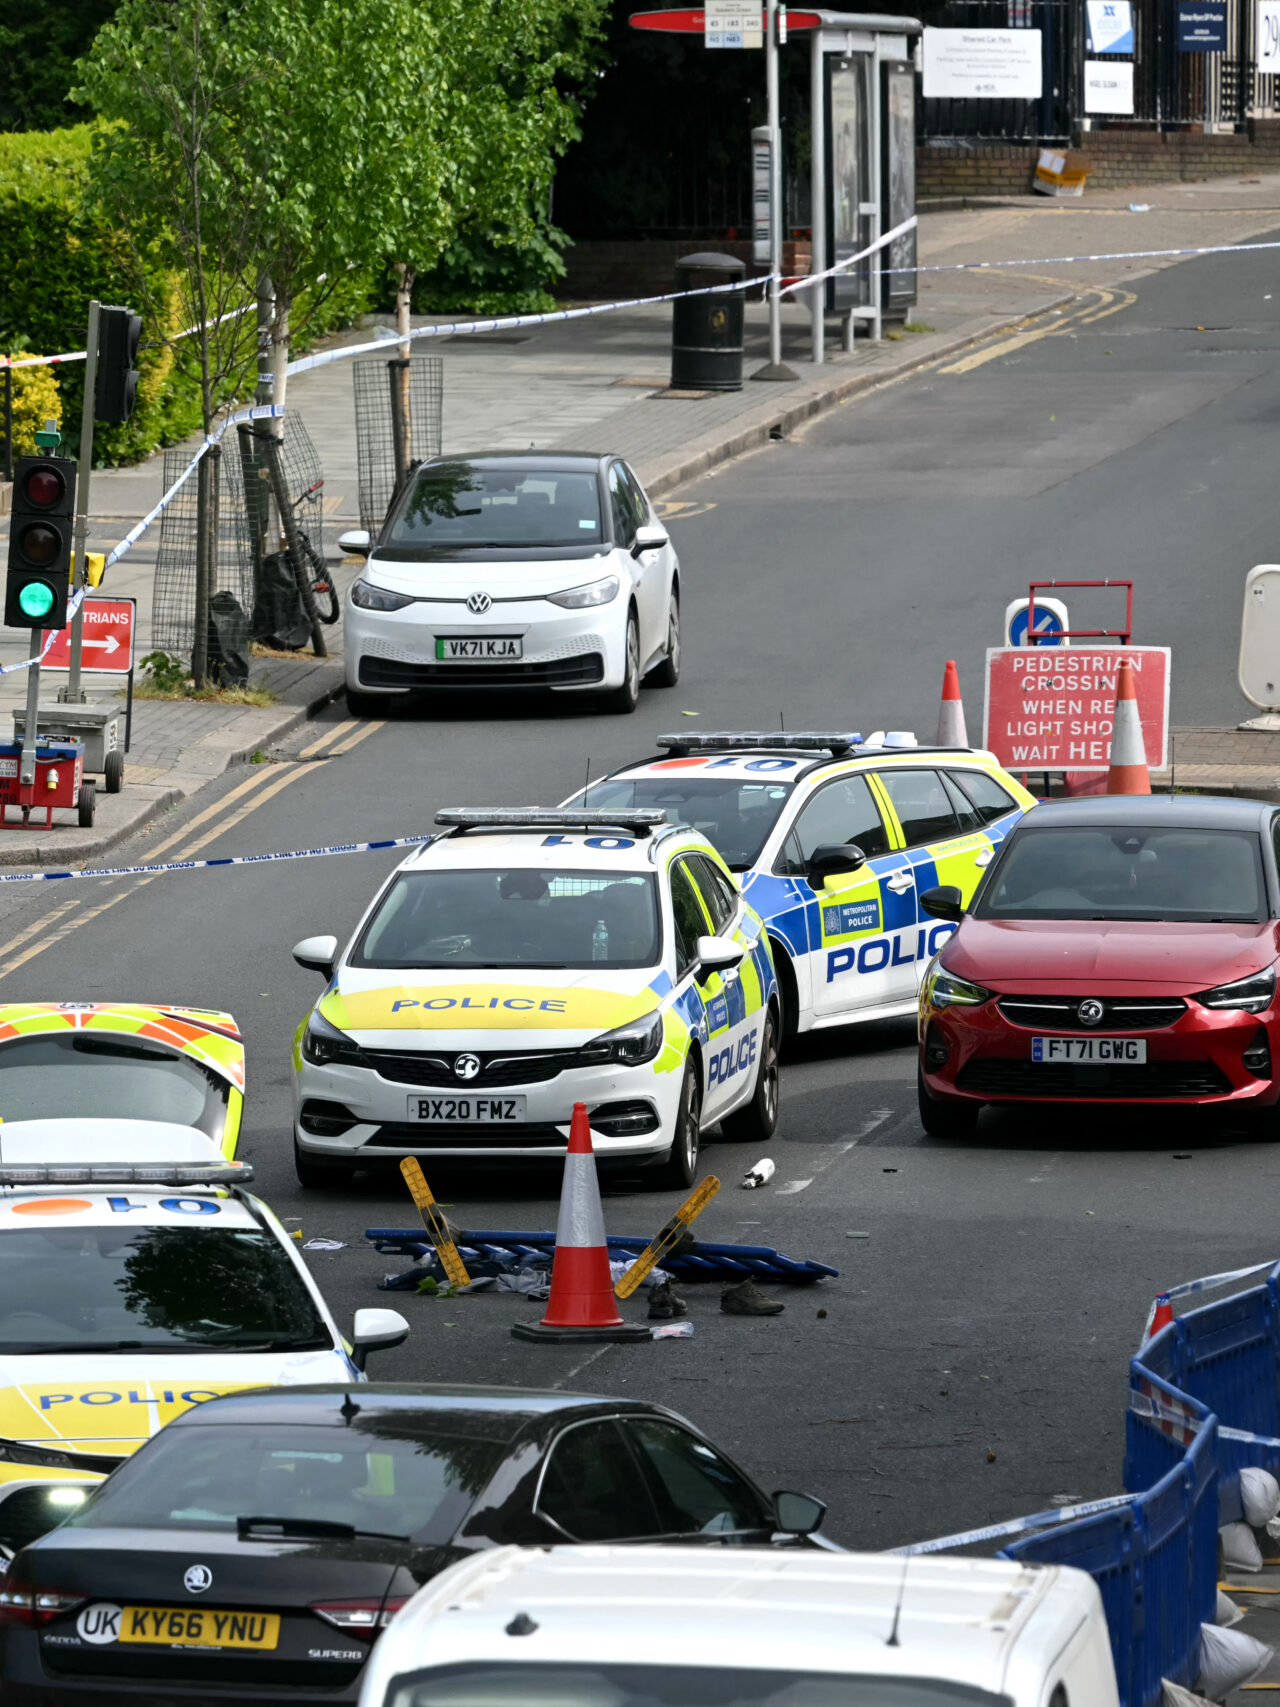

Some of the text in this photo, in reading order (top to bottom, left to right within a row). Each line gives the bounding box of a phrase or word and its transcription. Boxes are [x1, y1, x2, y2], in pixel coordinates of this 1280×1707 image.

[450, 641, 516, 655] VK71 KJA
[1022, 675, 1115, 691] CROSSIN
[1023, 700, 1115, 715] WHEN RE
[1007, 720, 1112, 736] LIGHT SHO
[1012, 745, 1060, 760] WAIT
[842, 903, 877, 916] METROPOLITAN
[848, 915, 873, 927] POLICE
[826, 922, 959, 983] POLIC
[391, 997, 568, 1013] POLICE
[1049, 1039, 1138, 1059] FT71 GWG
[707, 1027, 758, 1092] POLICE
[418, 1100, 516, 1119] BX20 FMZ
[39, 1390, 221, 1410] POLIC
[83, 1610, 119, 1636] UK
[131, 1612, 267, 1642] KY66 YNU
[308, 1648, 362, 1660] SUPERB
